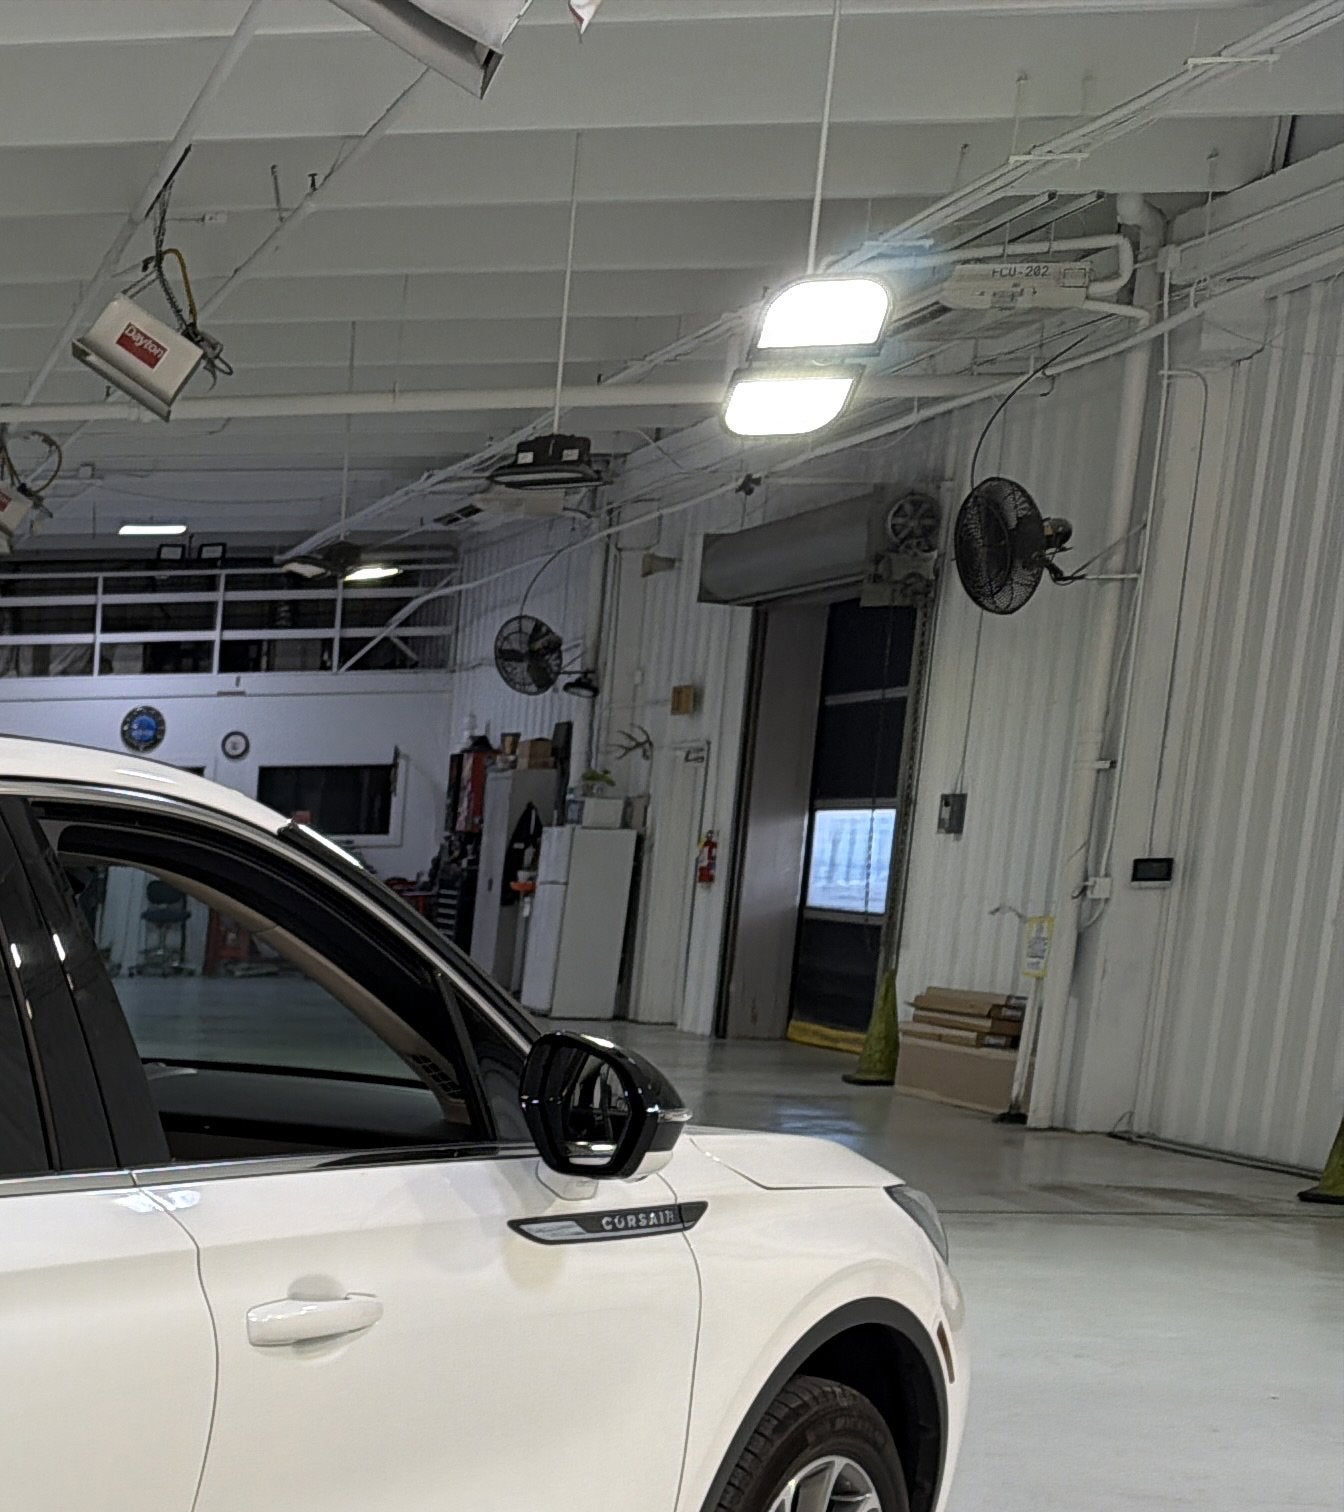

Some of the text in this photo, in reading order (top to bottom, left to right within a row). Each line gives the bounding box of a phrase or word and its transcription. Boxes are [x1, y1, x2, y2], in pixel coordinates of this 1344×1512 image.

[992, 265, 1050, 278] FCU-202
[124, 325, 165, 358] Dayton
[601, 1209, 675, 1231] CORSAIR
